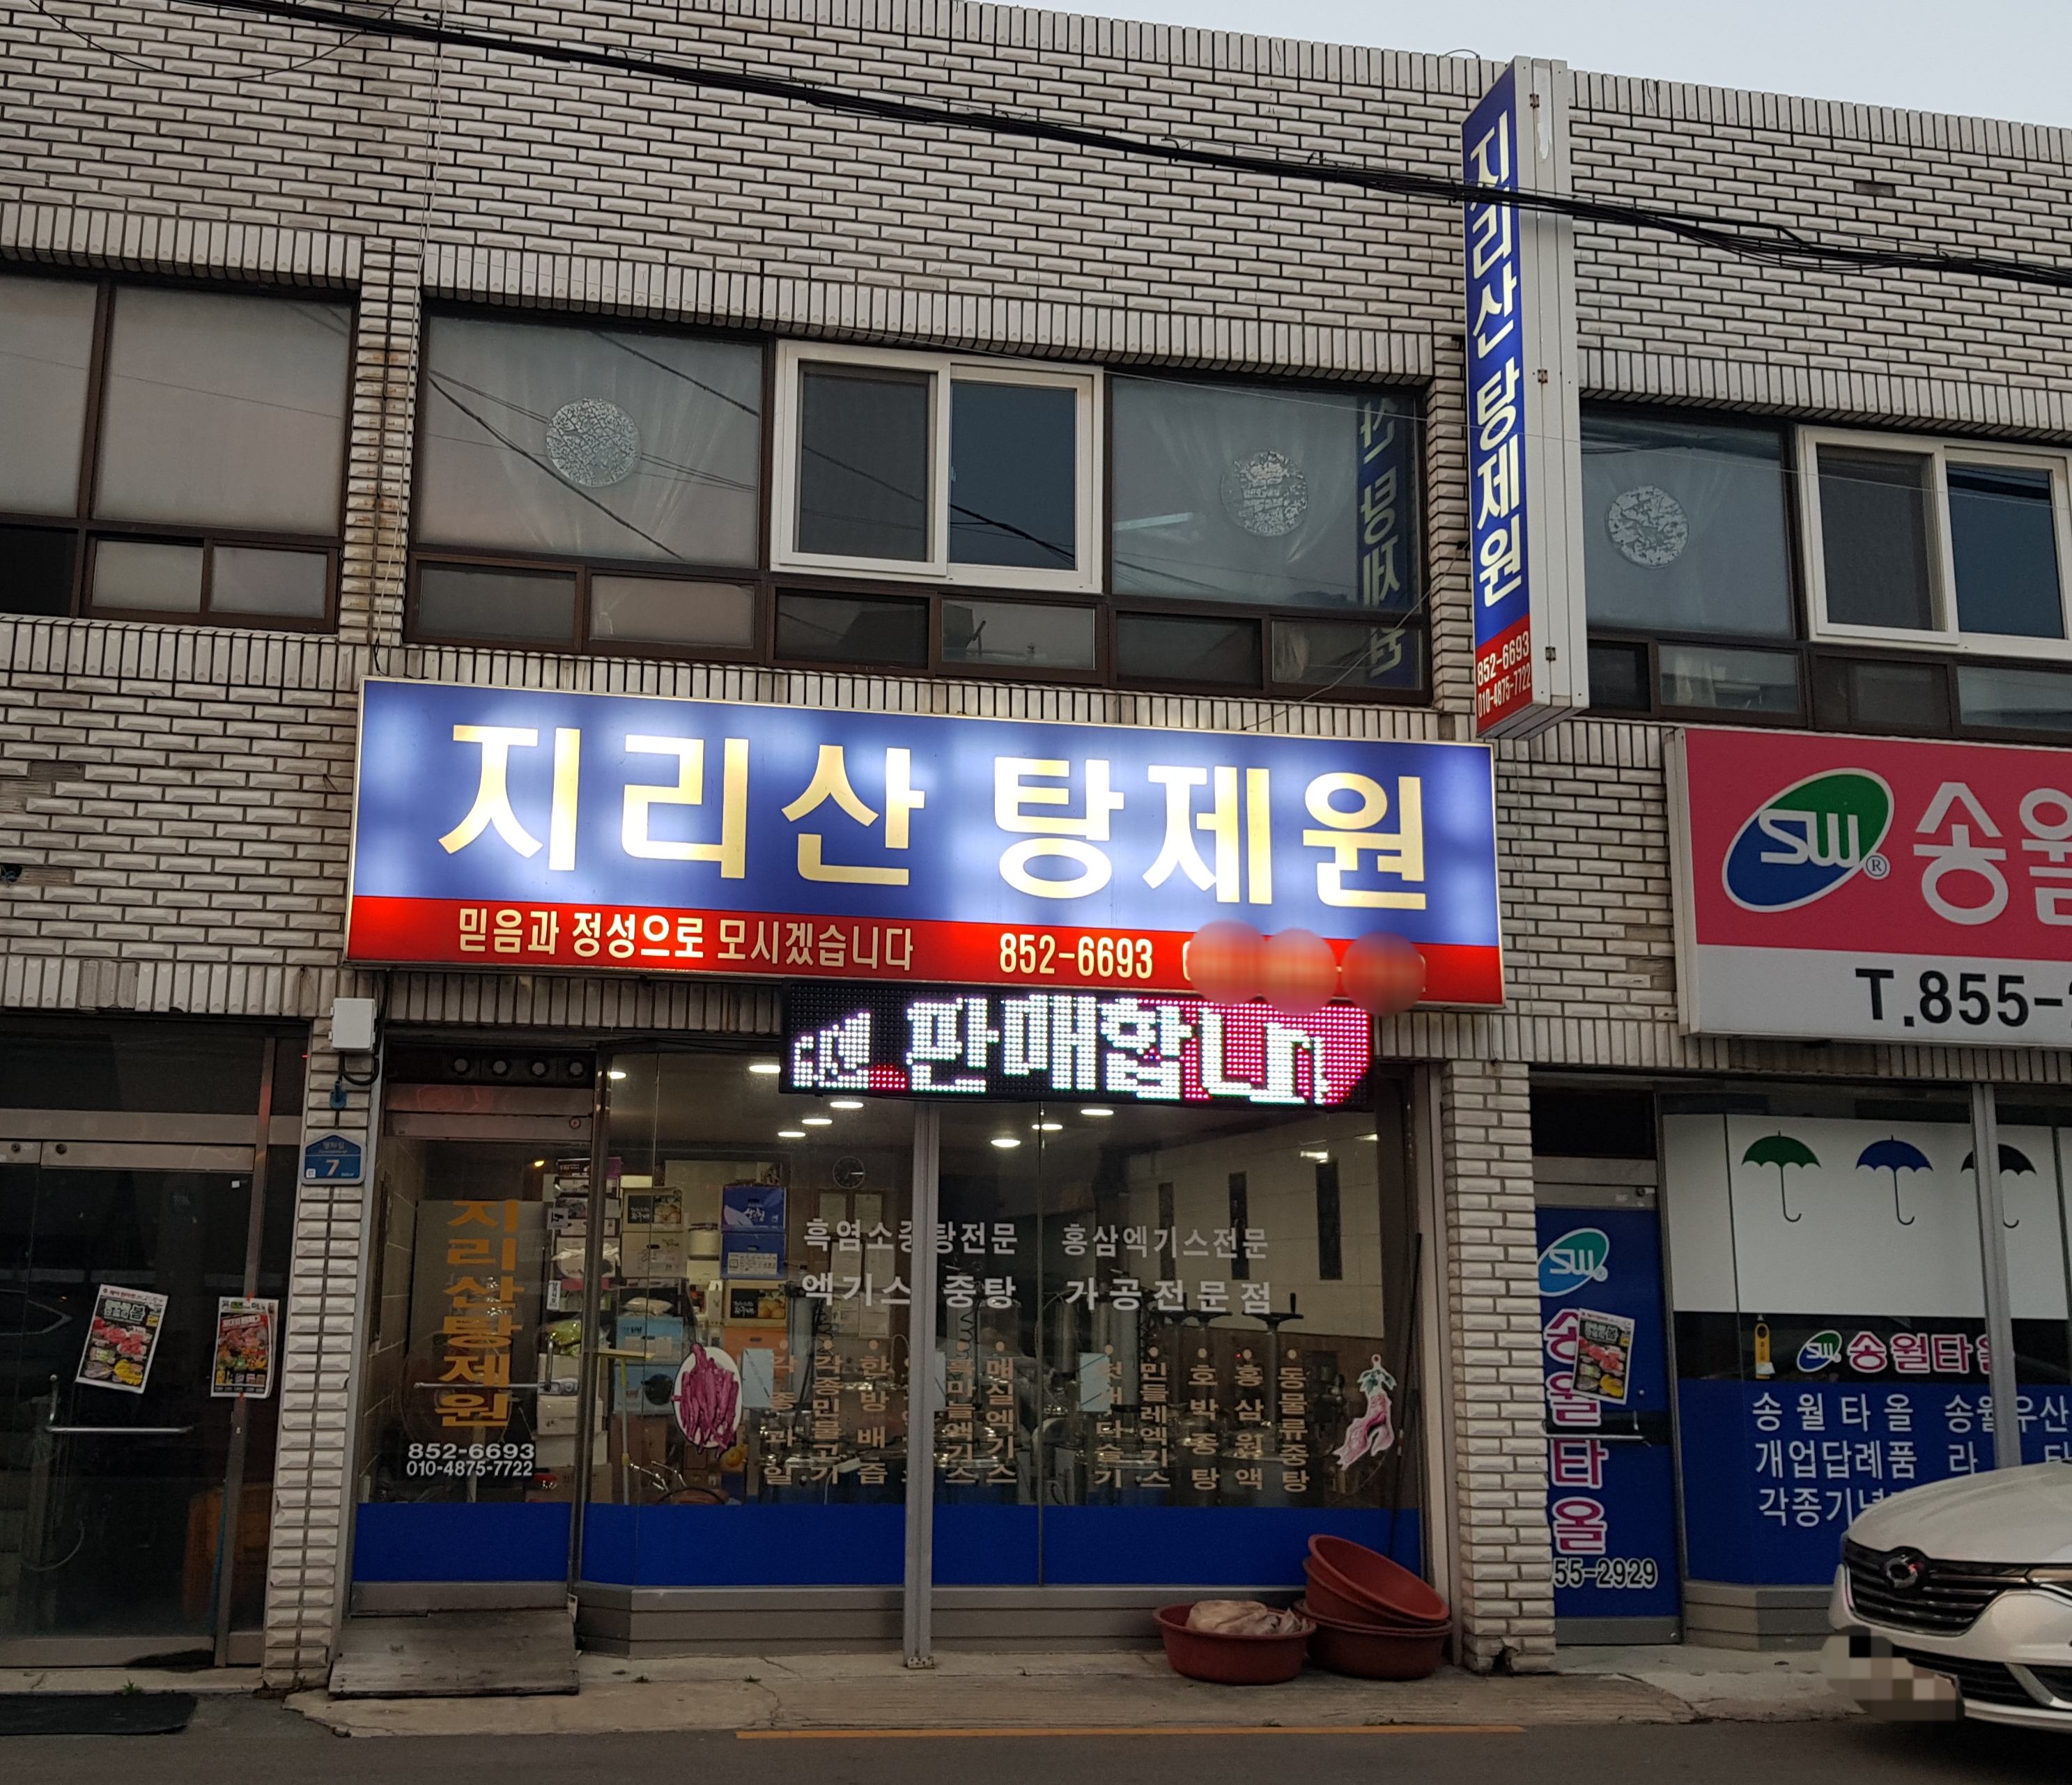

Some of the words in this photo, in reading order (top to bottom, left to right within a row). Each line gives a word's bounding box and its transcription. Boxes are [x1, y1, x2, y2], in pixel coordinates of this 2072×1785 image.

[1469, 110, 1517, 360] 지리산
[1476, 358, 1522, 608] 탕제원
[1478, 631, 1529, 686] 852-6693
[1478, 662, 1531, 718] 010-4875-7722
[438, 725, 925, 885] 지리산
[995, 757, 1425, 909] 탕제원
[459, 908, 559, 955] 믿음과
[573, 912, 704, 959] 정성으로
[718, 919, 913, 971] 모시겠습니다
[1000, 934, 1153, 979] 852-6693
[1855, 968, 2072, 1028] T.855-
[326, 1159, 340, 1177] 7
[1062, 1223, 1268, 1258] 홍삼엑기스전문
[802, 1272, 911, 1306] 엑기스
[943, 1275, 1016, 1308] 중탕
[1065, 1277, 1271, 1314] 가공전문점
[857, 1355, 890, 1485] 한방배즙
[1187, 1364, 1220, 1491] 호박중탕
[1278, 1366, 1311, 1493] 동물류중탕
[406, 1460, 534, 1477] 010-4875-7722
[408, 1442, 535, 1460] 852-6693
[1754, 1439, 1918, 1481] 개업답례품
[1758, 1487, 1908, 1529] 각종기
